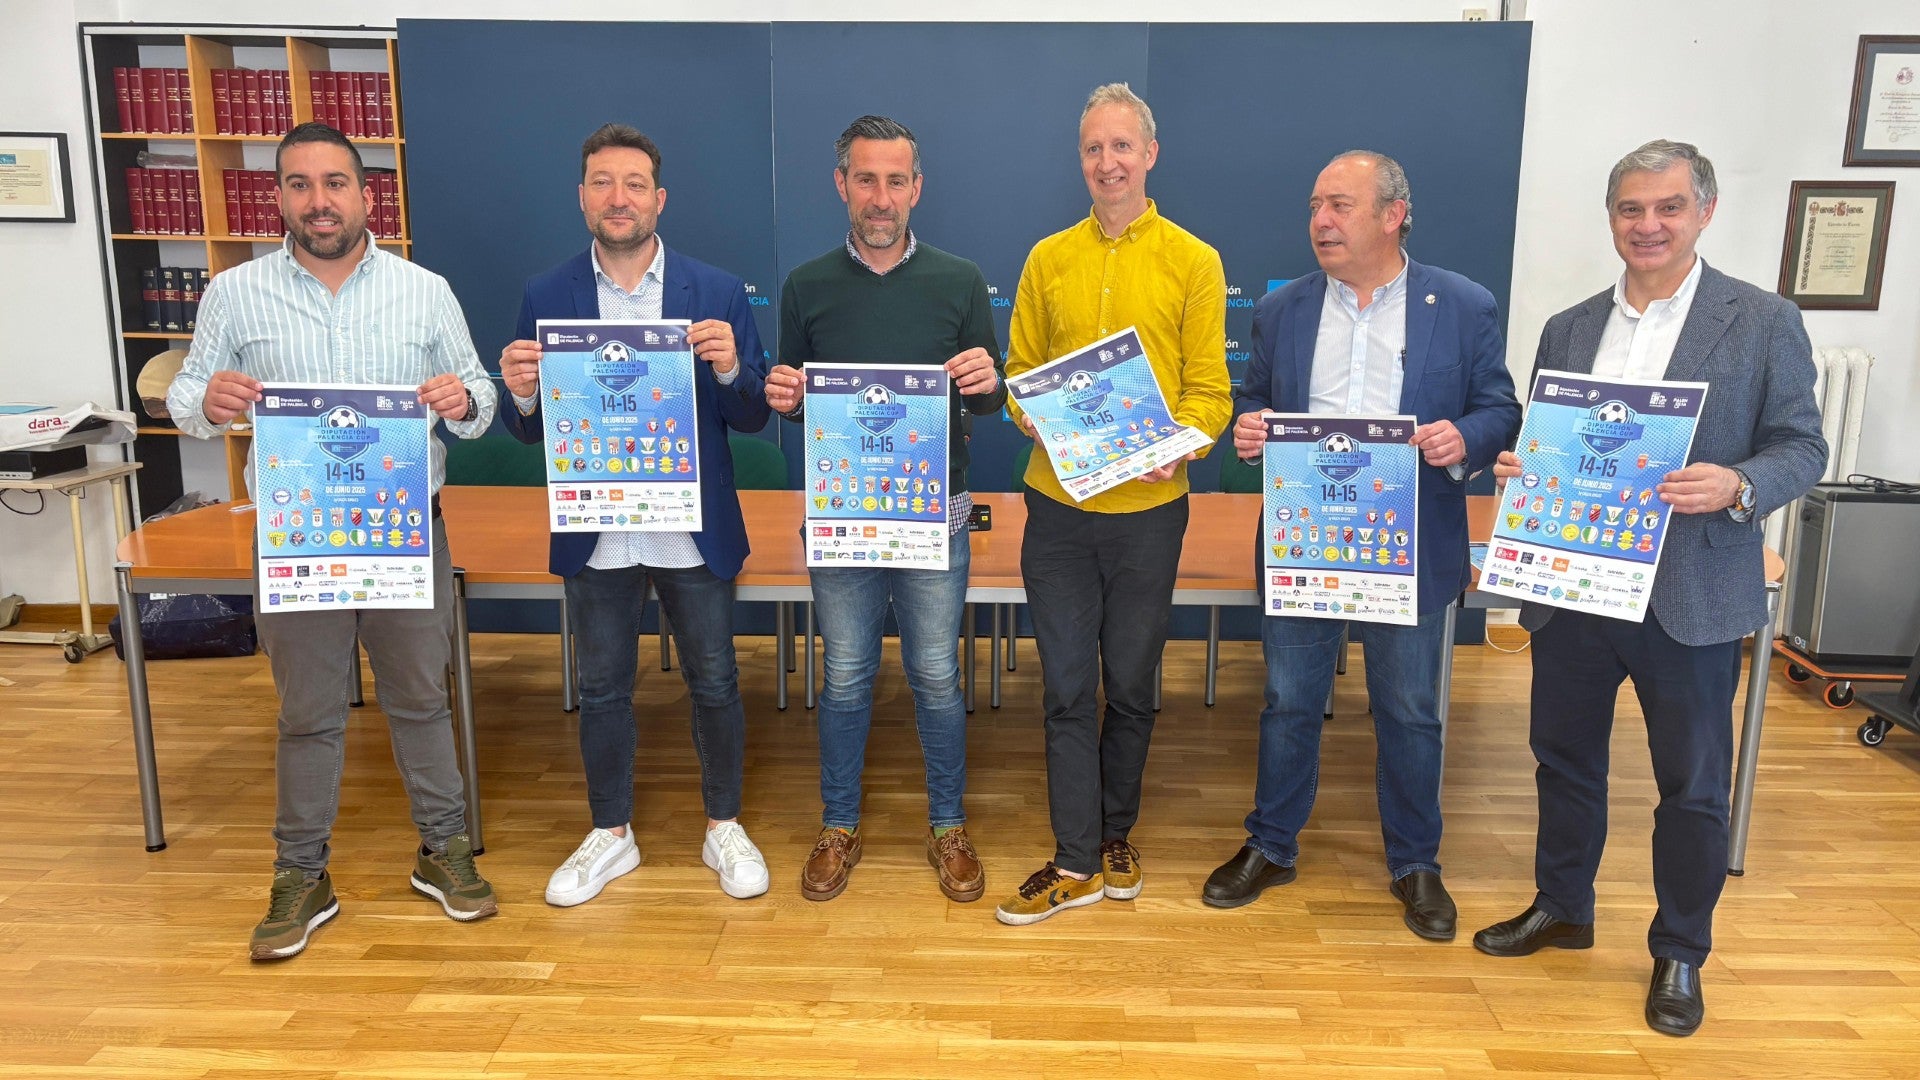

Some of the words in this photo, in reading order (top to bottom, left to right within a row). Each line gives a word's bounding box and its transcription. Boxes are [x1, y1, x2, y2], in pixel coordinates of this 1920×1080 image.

[600, 394, 637, 412] 14-15
[1066, 393, 1093, 404] PALENCIA
[28, 417, 62, 429] dara
[1080, 410, 1114, 427] 14-15
[1587, 422, 1631, 430] DIPUTACIÓN
[1582, 427, 1617, 436] PALENCIA
[860, 436, 894, 452] 14-15
[325, 463, 365, 481] 14-15
[1578, 454, 1619, 477] 14-15
[1582, 480, 1599, 488] JUNIO
[1321, 484, 1357, 501] 14-15
